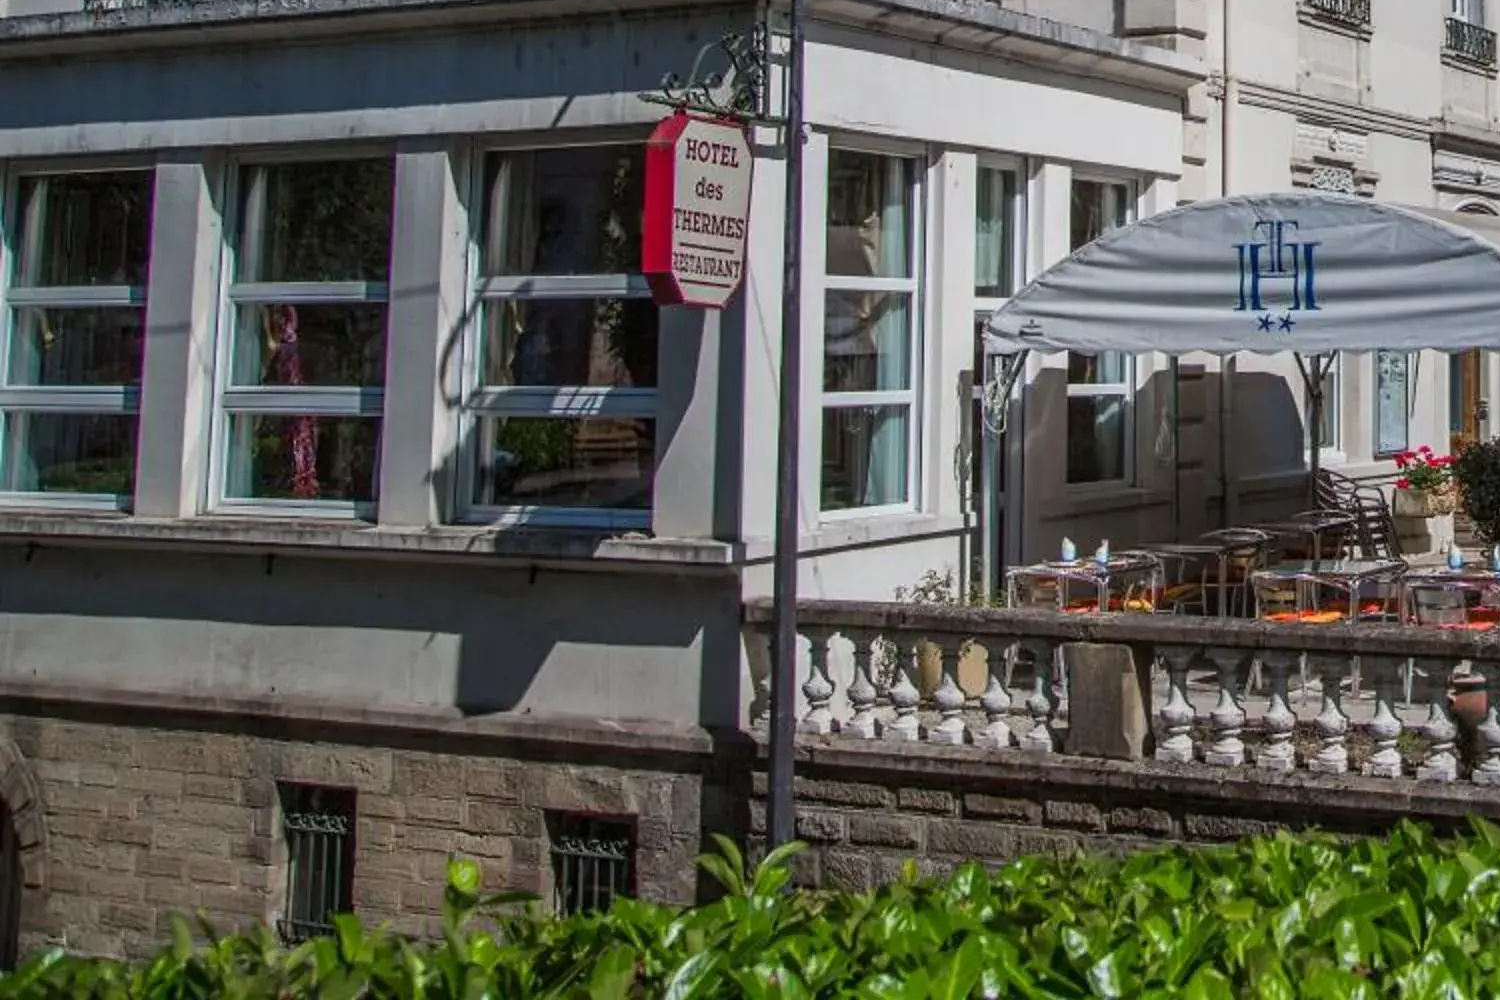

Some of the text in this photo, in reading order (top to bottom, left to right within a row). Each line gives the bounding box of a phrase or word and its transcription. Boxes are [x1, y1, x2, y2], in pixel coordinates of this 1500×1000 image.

[685, 138, 740, 168] HOTEL
[695, 177, 724, 201] des
[673, 207, 745, 239] THERMES
[673, 252, 741, 279] RESTAURANT
